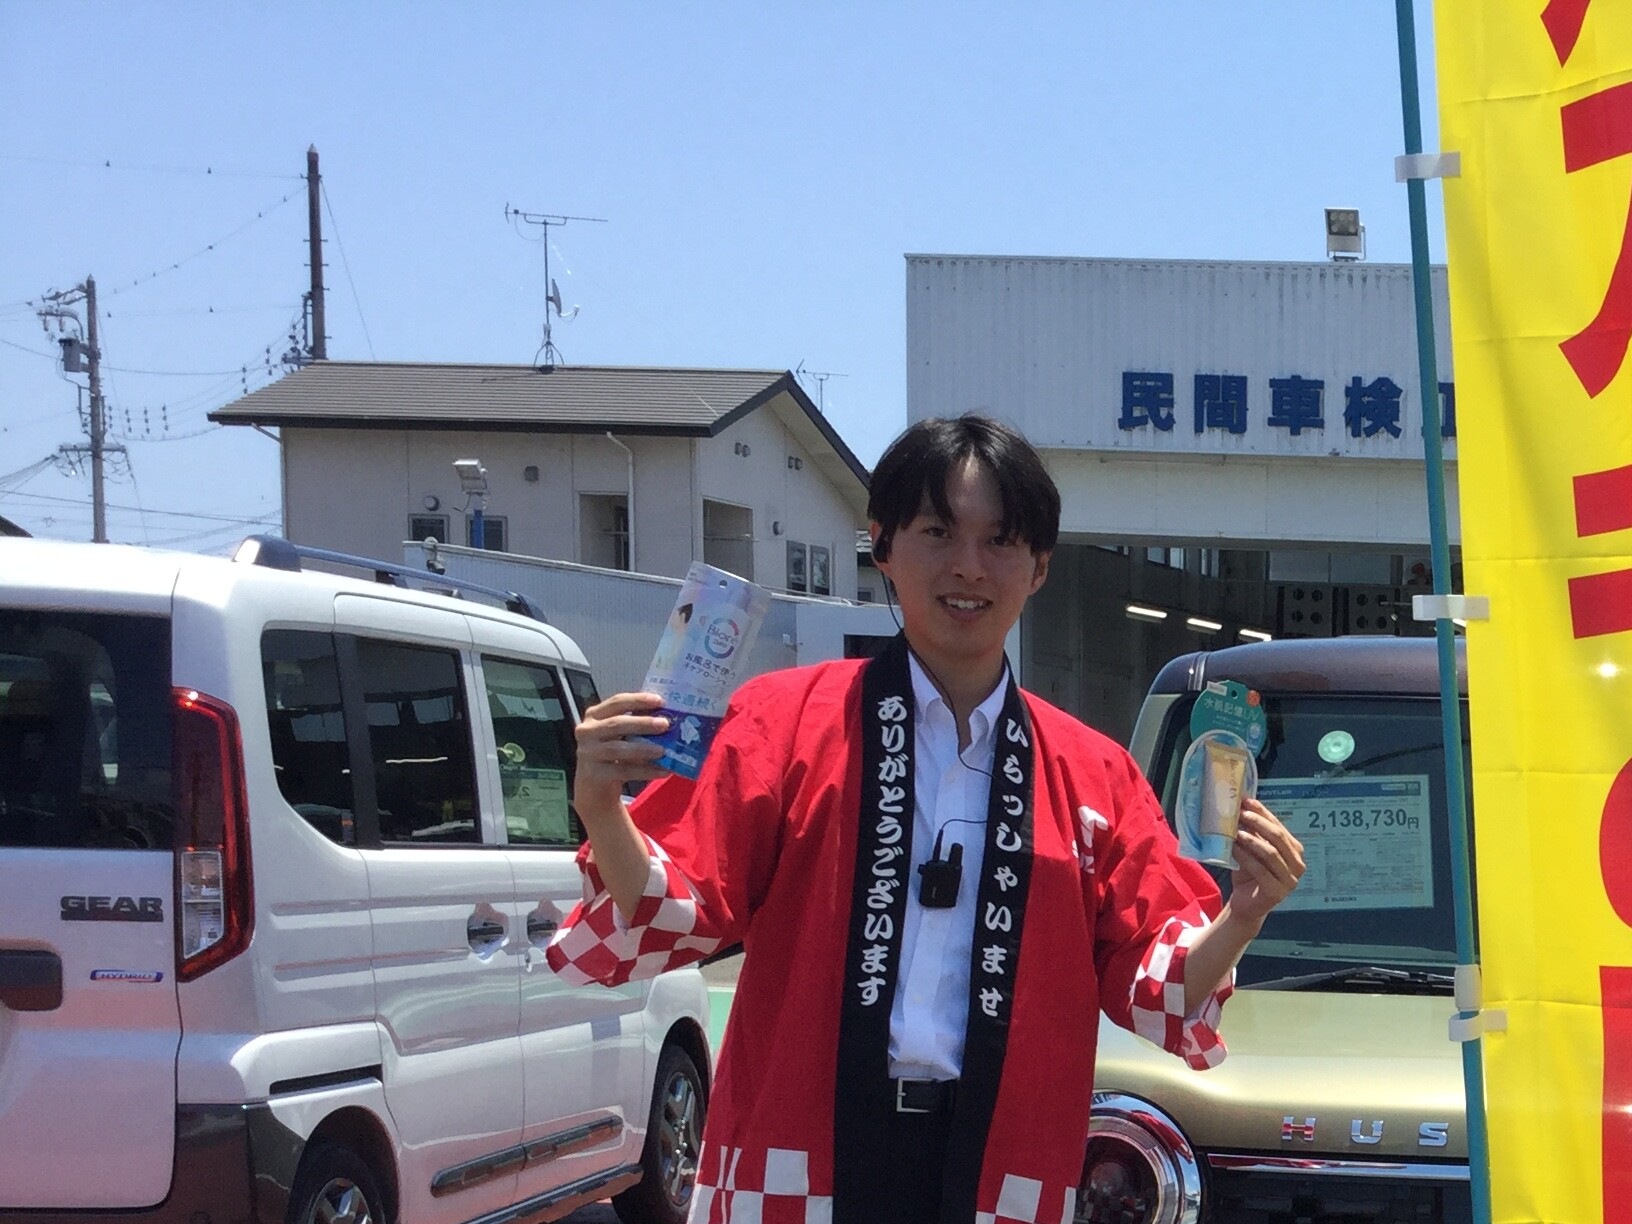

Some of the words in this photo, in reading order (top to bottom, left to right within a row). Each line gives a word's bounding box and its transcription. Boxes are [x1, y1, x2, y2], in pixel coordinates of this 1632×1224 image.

[857, 695, 910, 1007] ありがとうございます
[979, 718, 1029, 1017] いらっしゃいませ
[1308, 809, 1420, 832] 2,138,730円
[60, 895, 164, 919] GEAR
